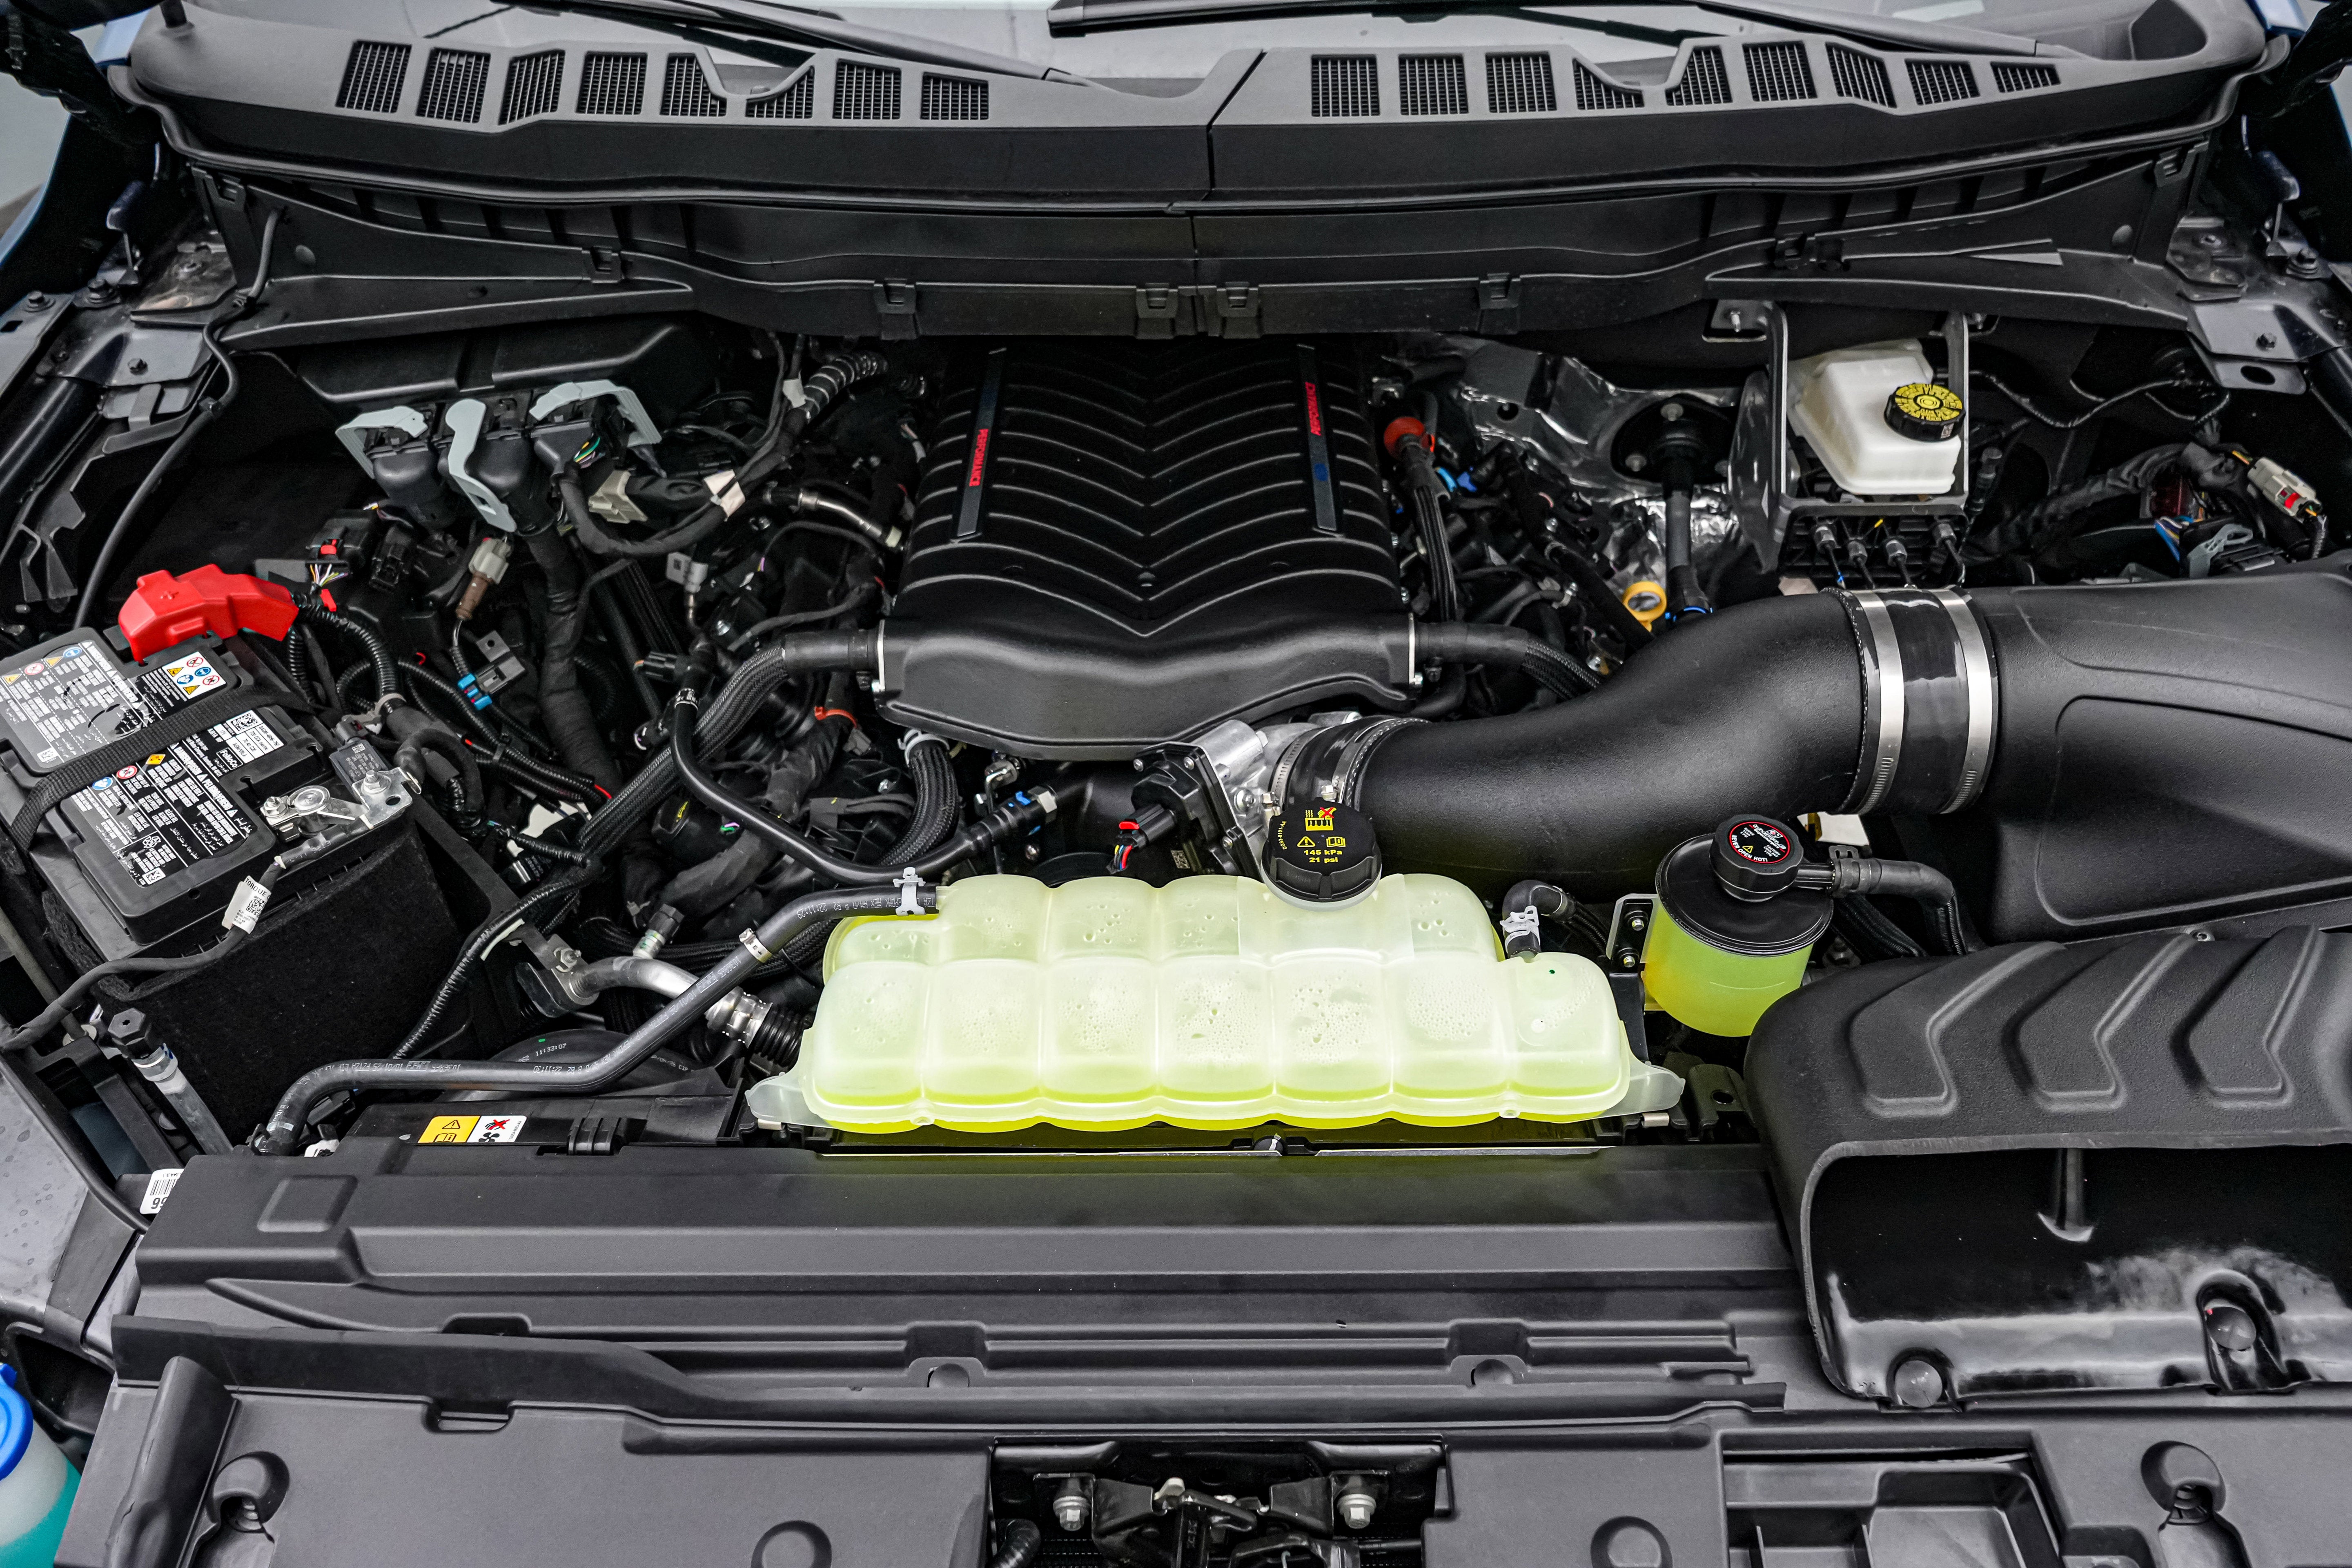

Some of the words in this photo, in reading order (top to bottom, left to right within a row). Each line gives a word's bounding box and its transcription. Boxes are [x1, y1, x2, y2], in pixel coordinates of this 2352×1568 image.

[969, 429, 989, 486] PERFORMANCE
[218, 749, 240, 768] FoMoCo
[172, 746, 203, 776] DANGER/POISON
[200, 779, 234, 811] PELIGRO/VENENO
[1731, 834, 1740, 849] NEVER
[1738, 849, 1752, 859] OPEN
[1763, 846, 1779, 857] COOLANT
[1766, 845, 1781, 855] FACTORY
[245, 878, 267, 897] TORQUE
[535, 1043, 567, 1057] 11:33:07
